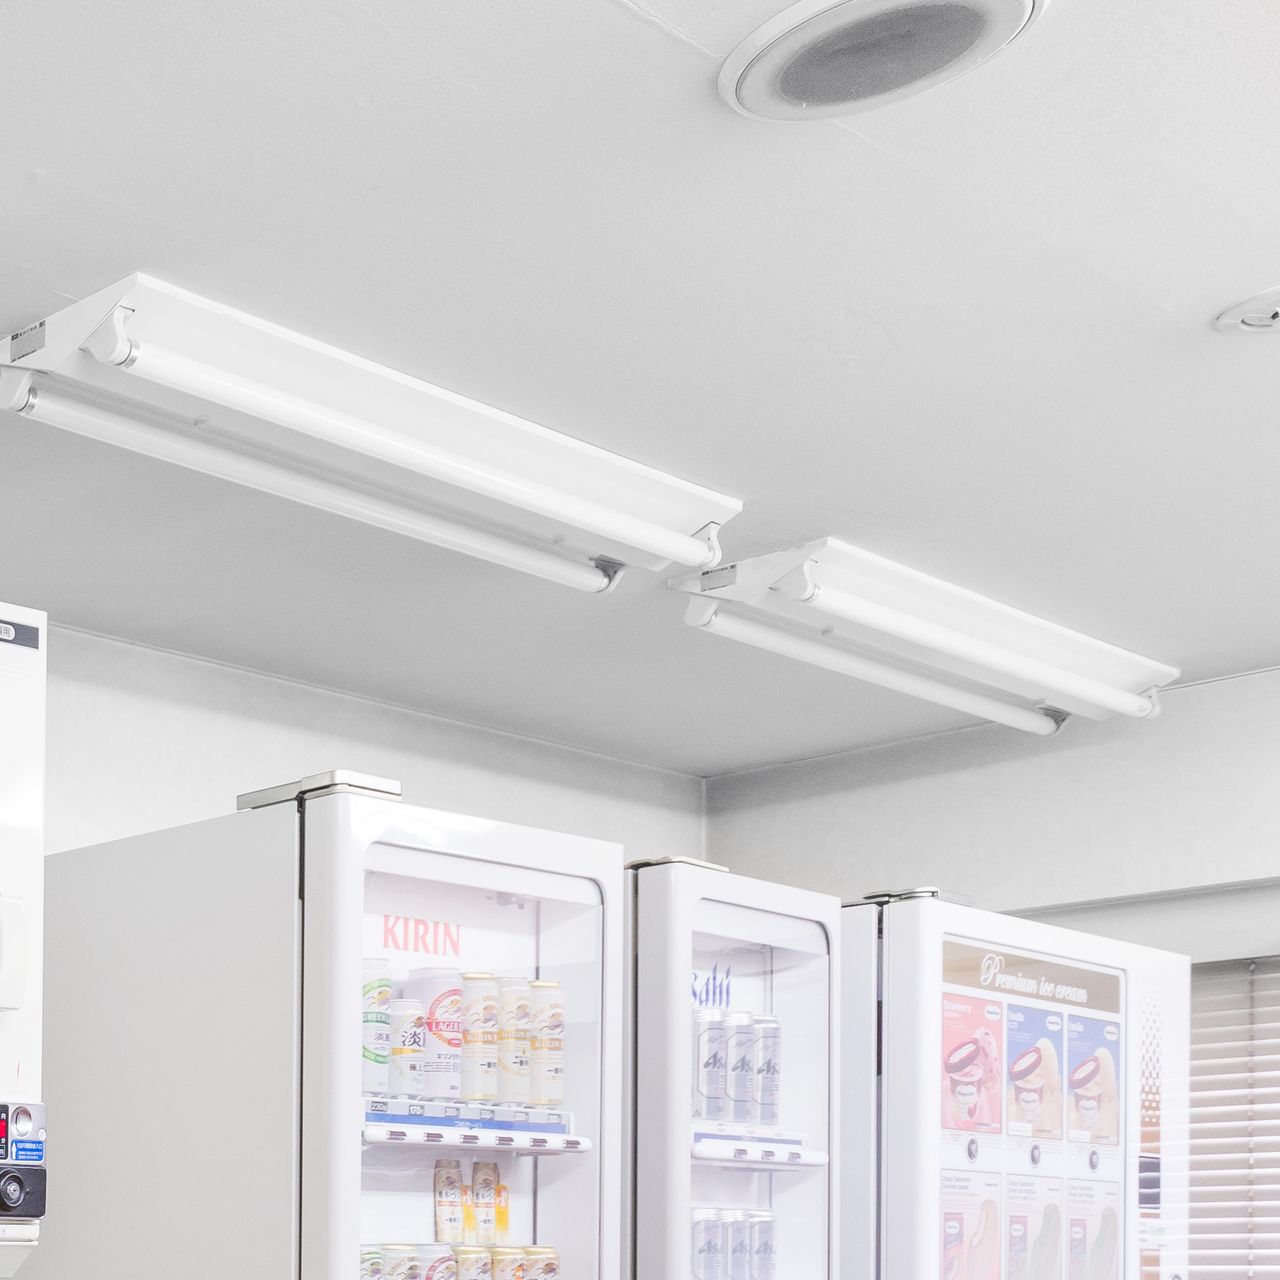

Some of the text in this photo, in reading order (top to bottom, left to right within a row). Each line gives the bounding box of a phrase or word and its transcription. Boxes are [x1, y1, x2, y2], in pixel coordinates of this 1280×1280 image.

[383, 914, 461, 957] KIRIN
[980, 953, 1038, 995] Premium
[1040, 976, 1053, 998] ice
